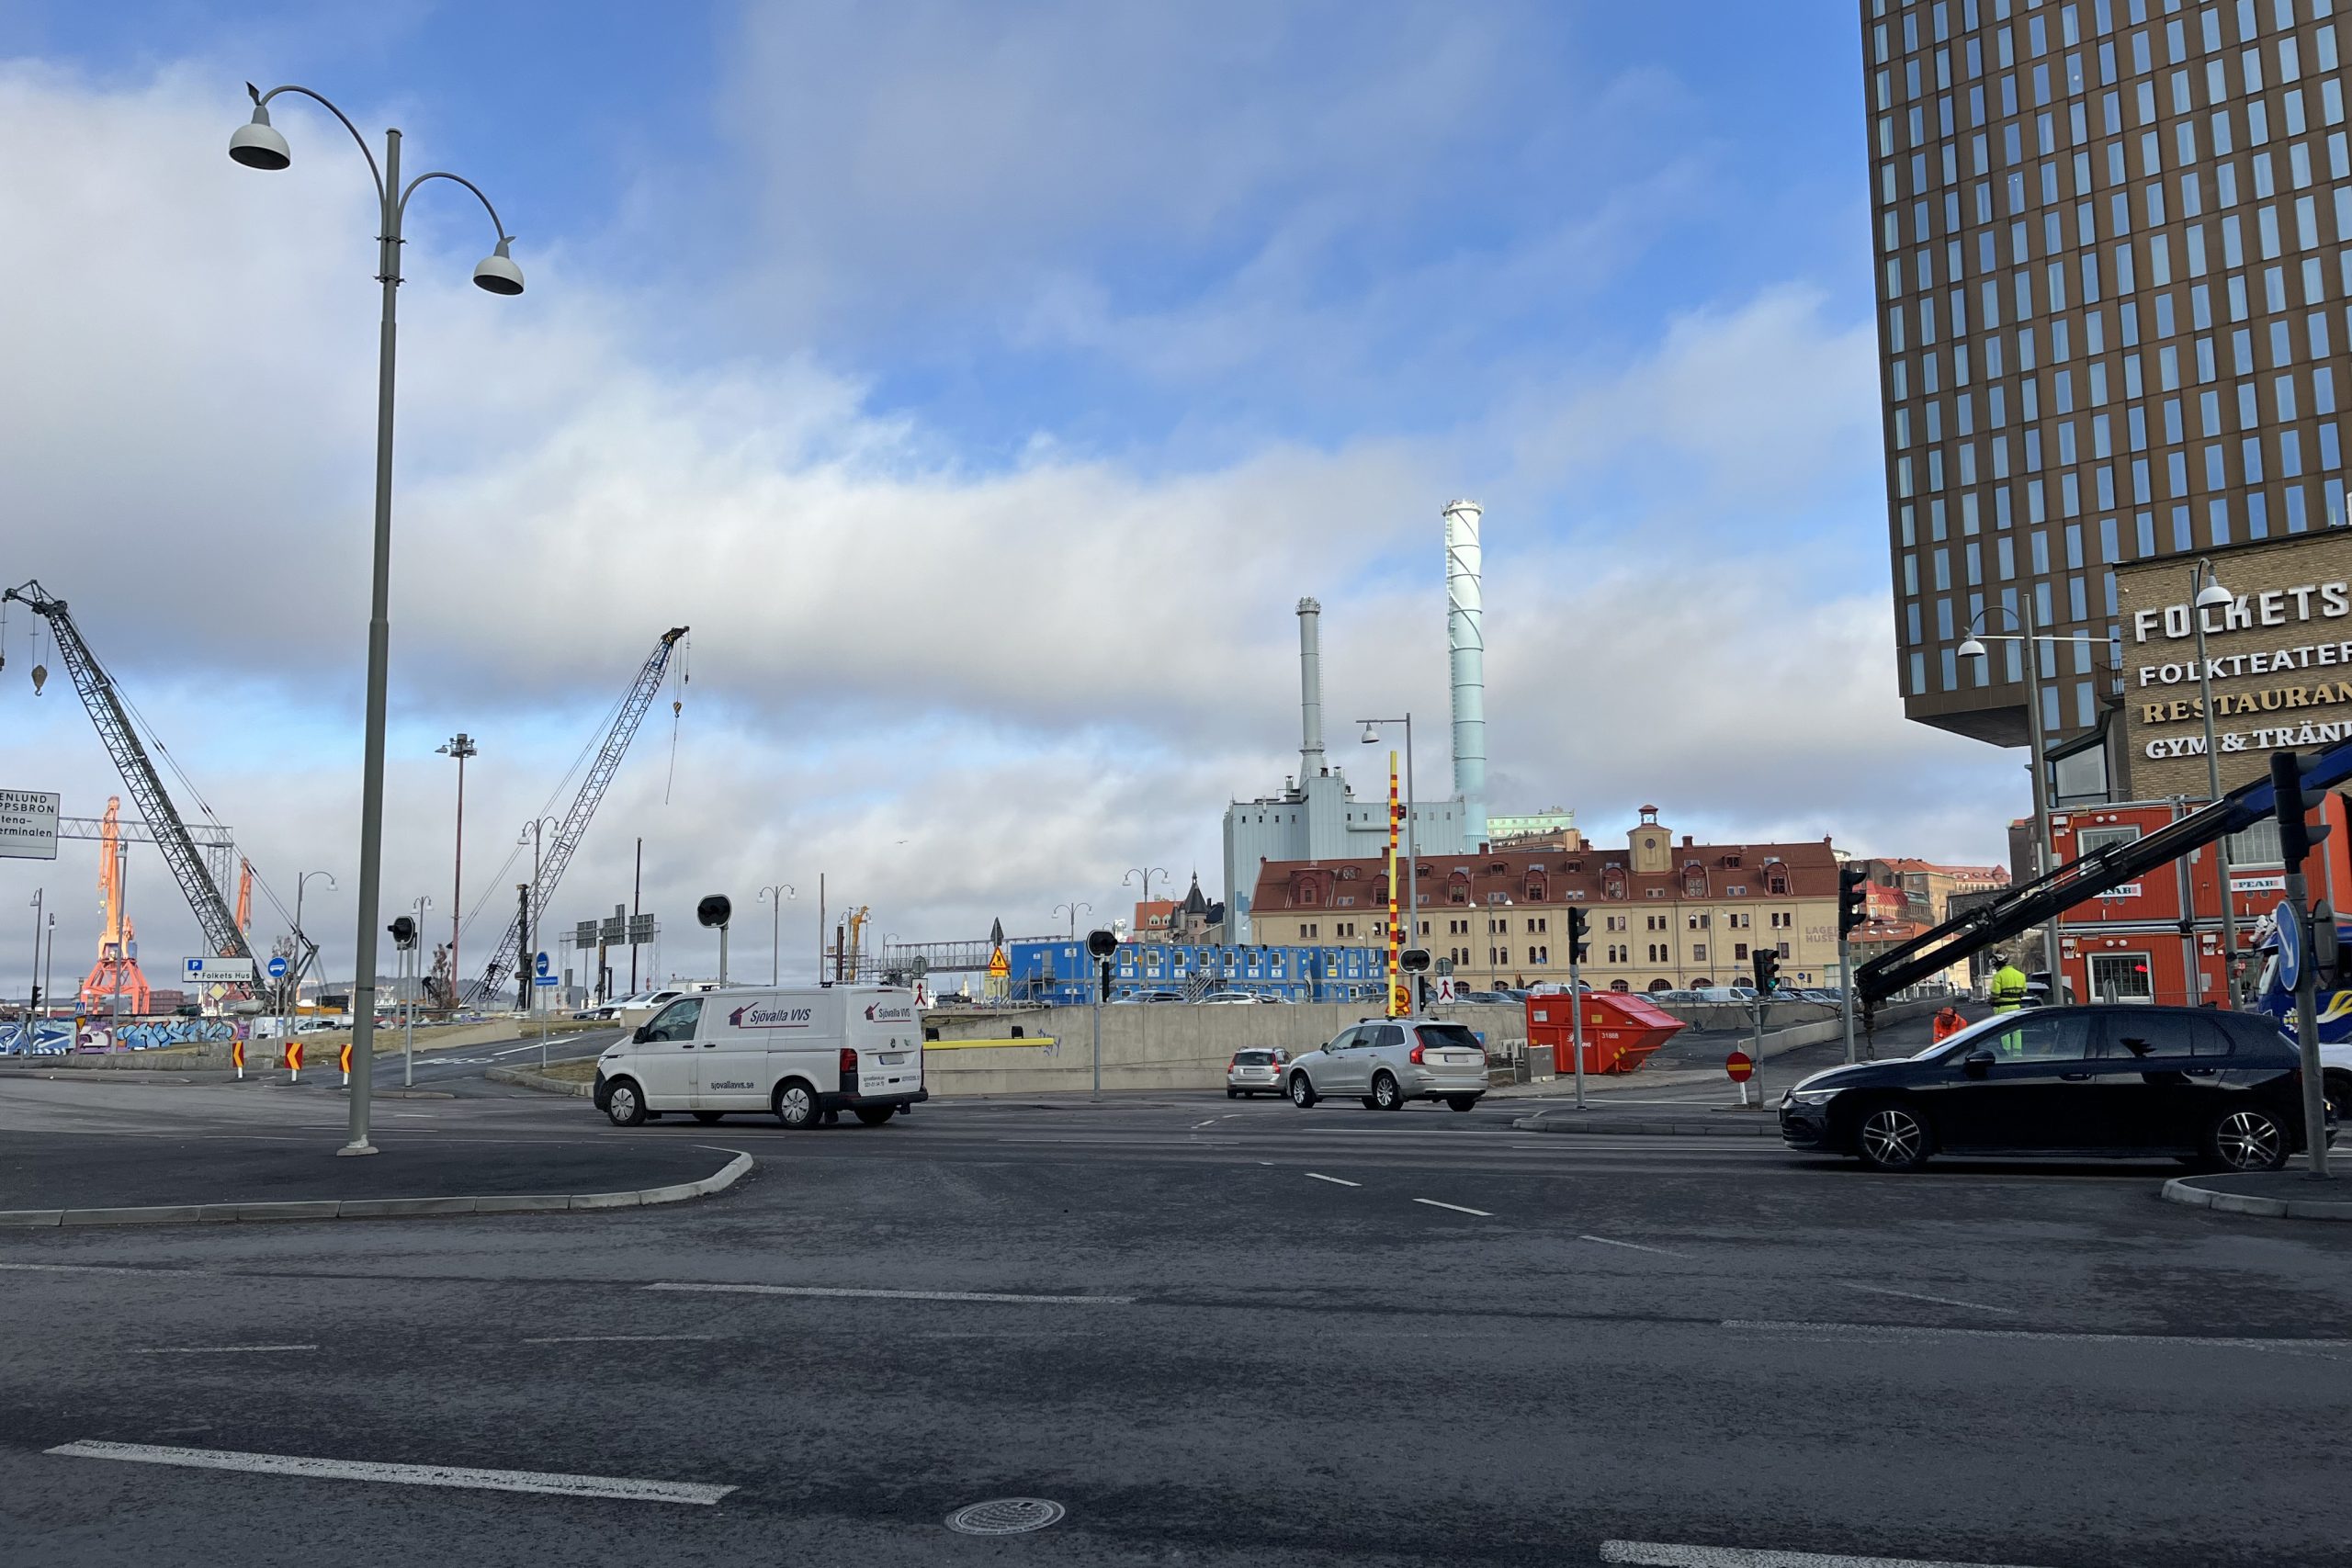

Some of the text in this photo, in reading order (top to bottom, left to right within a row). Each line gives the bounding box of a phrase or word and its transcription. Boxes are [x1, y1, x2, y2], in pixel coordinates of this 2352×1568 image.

[2134, 581, 2349, 643] FOLKETS
[2145, 736, 2209, 760] GYM
[2221, 732, 2247, 753] &
[2239, 880, 2273, 888] PEAB
[750, 1008, 811, 1025] Sjövalla VVS
[901, 1008, 910, 1017] VVS
